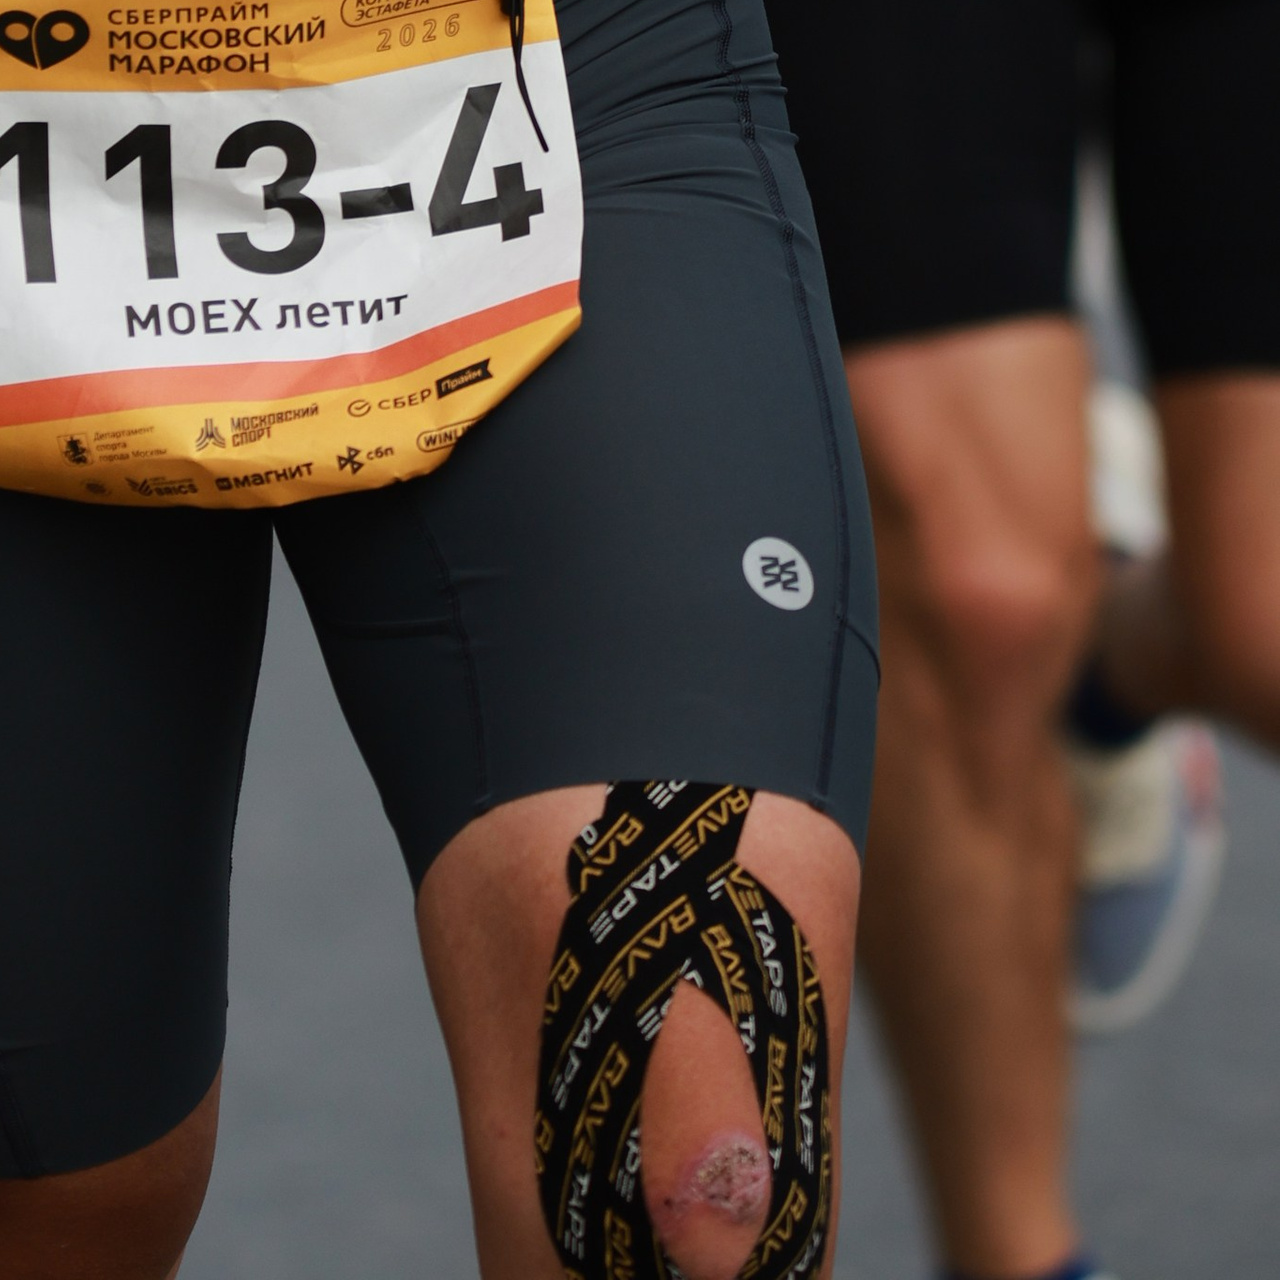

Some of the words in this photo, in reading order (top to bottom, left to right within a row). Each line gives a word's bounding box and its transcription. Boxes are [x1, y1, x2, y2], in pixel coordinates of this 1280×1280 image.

[107, 0, 270, 26] СБЕРПРАЙМ
[108, 16, 326, 50] МОСКОВСКИЙ
[376, 13, 460, 52] 2026
[108, 52, 271, 75] МАРАФОН
[274, 294, 409, 330] летит
[377, 388, 432, 410] СБЕР
[440, 368, 484, 393] Прайм
[230, 402, 320, 433] МОСКОВСКИЙ
[231, 426, 273, 448] СПОРТ
[366, 446, 395, 461] сбп
